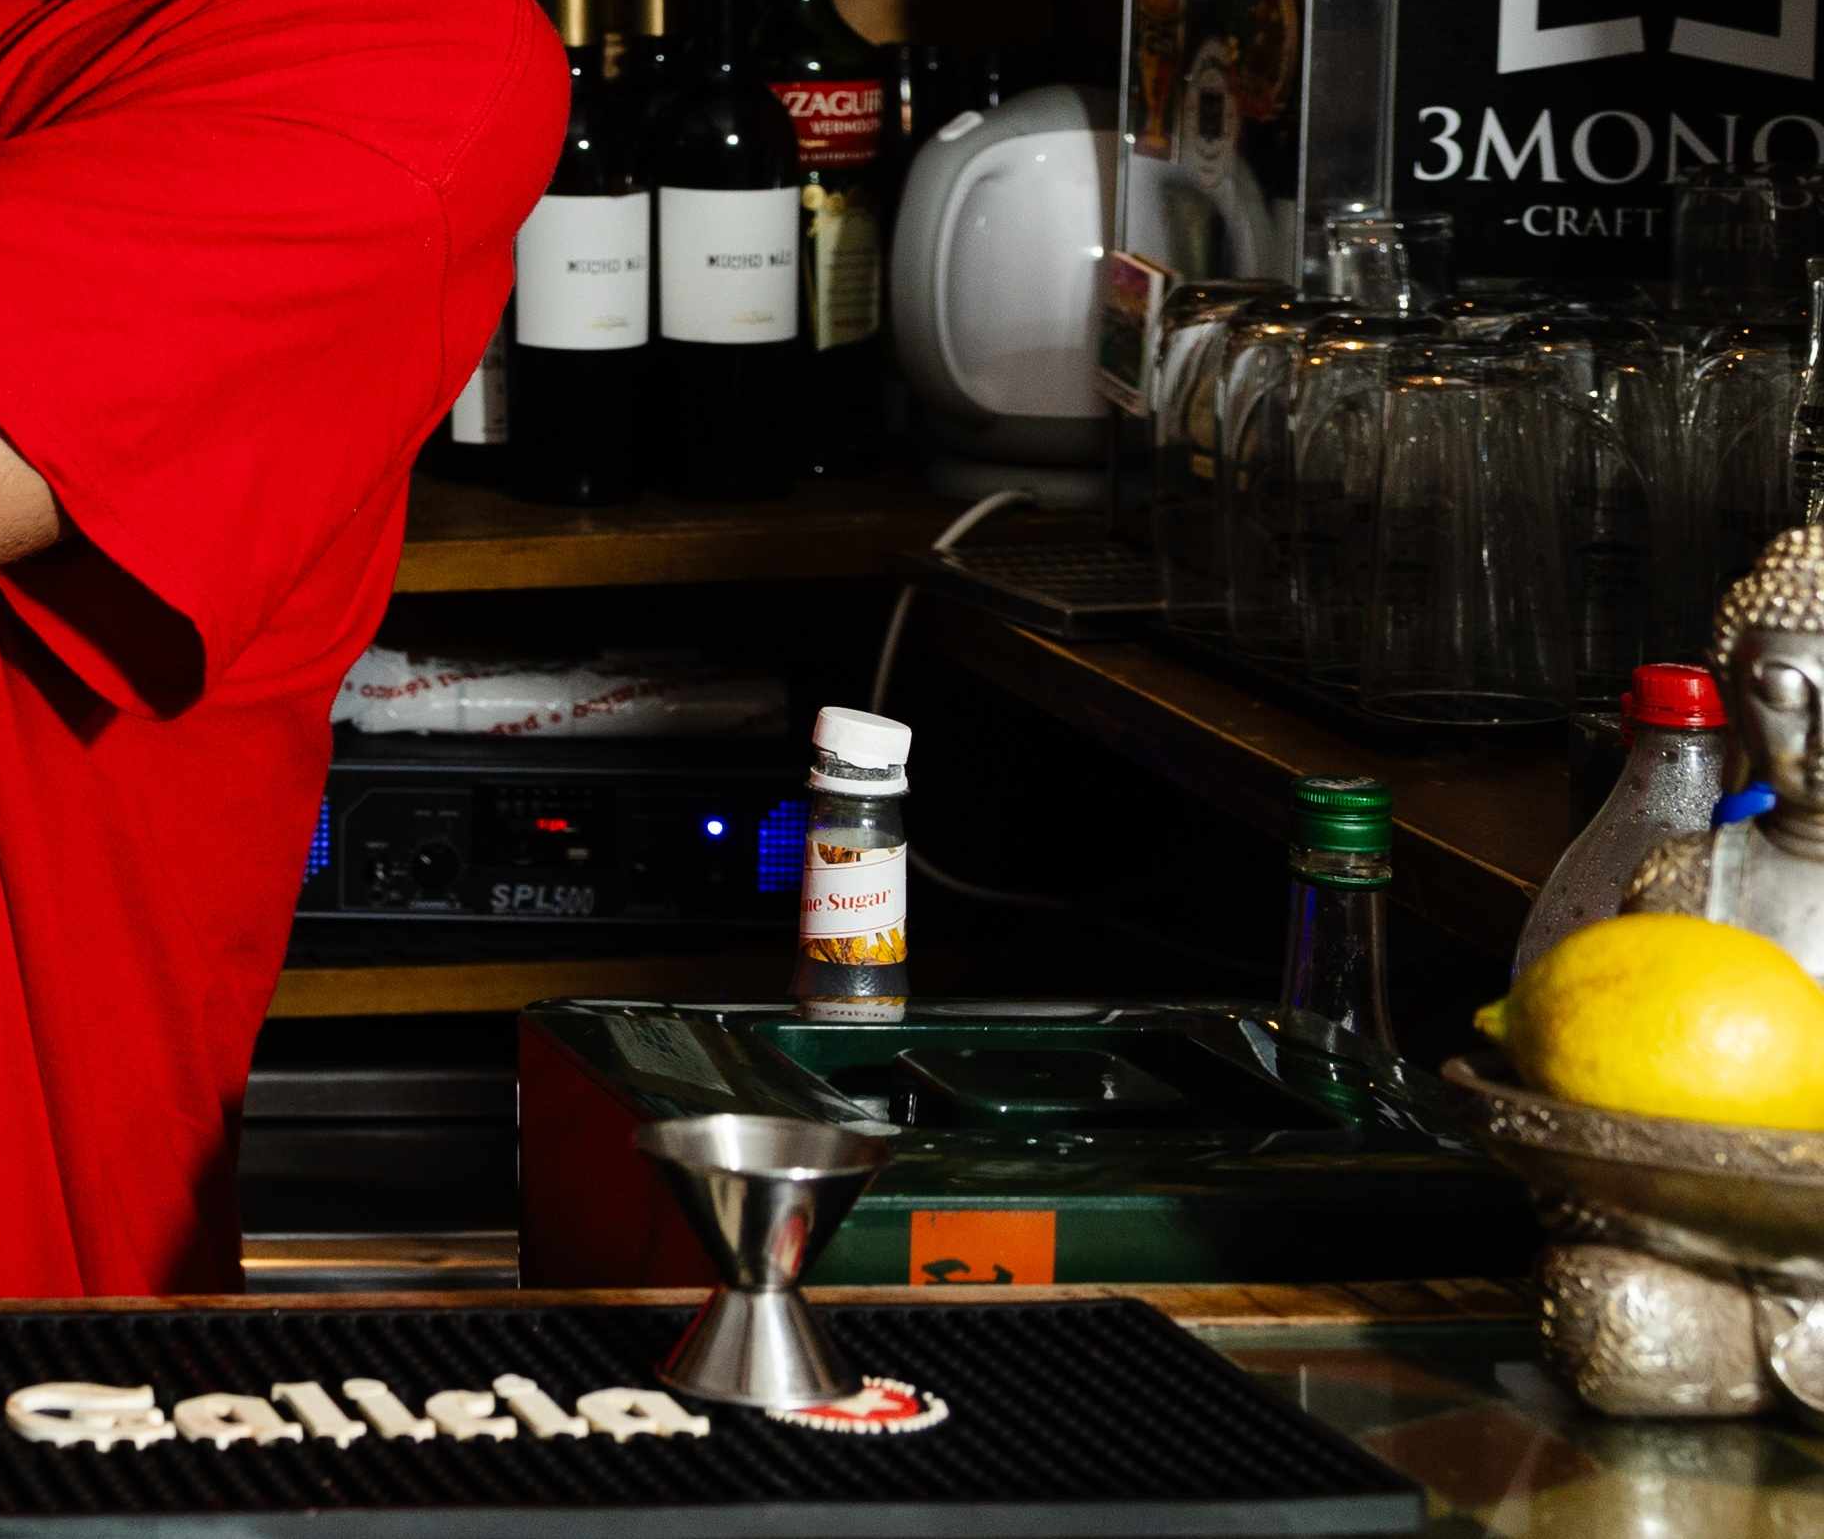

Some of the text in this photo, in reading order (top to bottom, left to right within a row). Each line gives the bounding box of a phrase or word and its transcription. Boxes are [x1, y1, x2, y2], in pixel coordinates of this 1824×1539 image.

[706, 253, 764, 270] MUCHO
[827, 889, 893, 913] Sugar
[5, 1373, 712, 1450] Galicia
